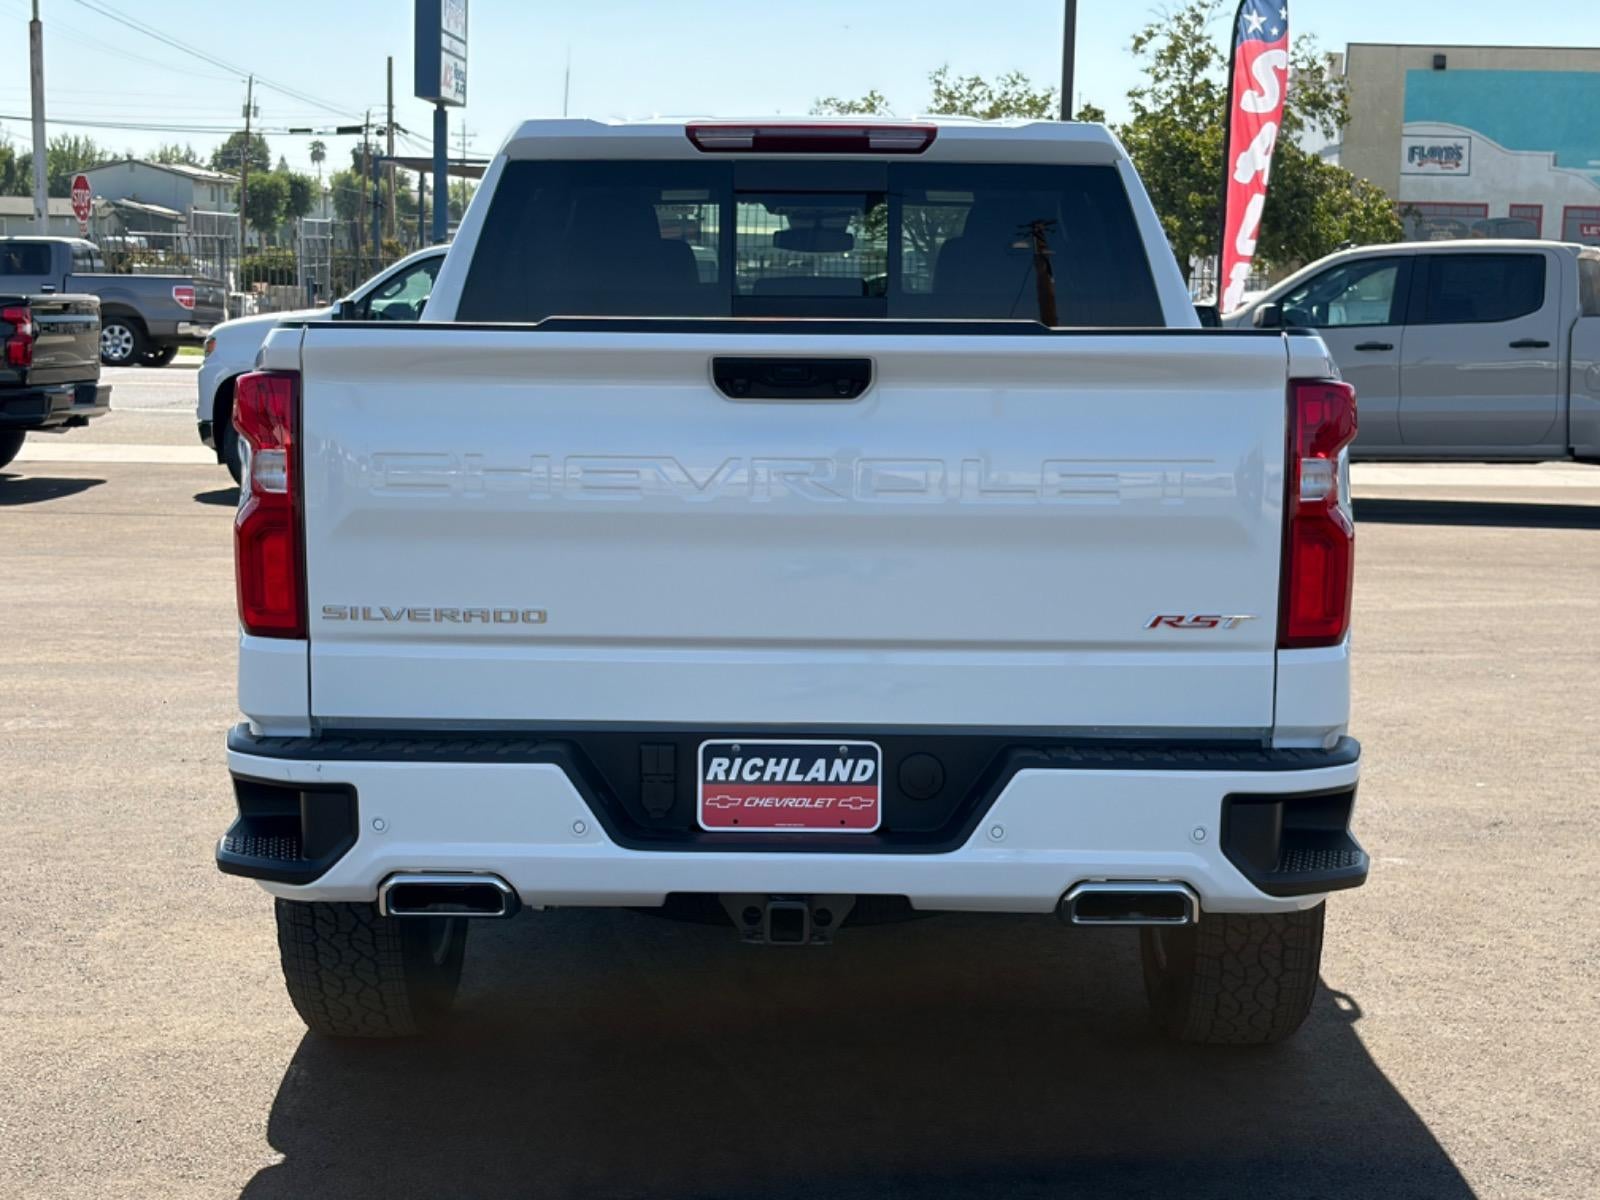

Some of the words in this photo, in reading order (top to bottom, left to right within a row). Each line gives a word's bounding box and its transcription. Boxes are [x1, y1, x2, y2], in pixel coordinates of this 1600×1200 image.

[72, 189, 91, 208] STOP
[370, 452, 1215, 504] CHEVROLET
[322, 605, 548, 624] SILVERADO
[1143, 612, 1260, 629] RST
[705, 757, 876, 782] RICHLAND
[743, 797, 837, 808] CHEVROLET
